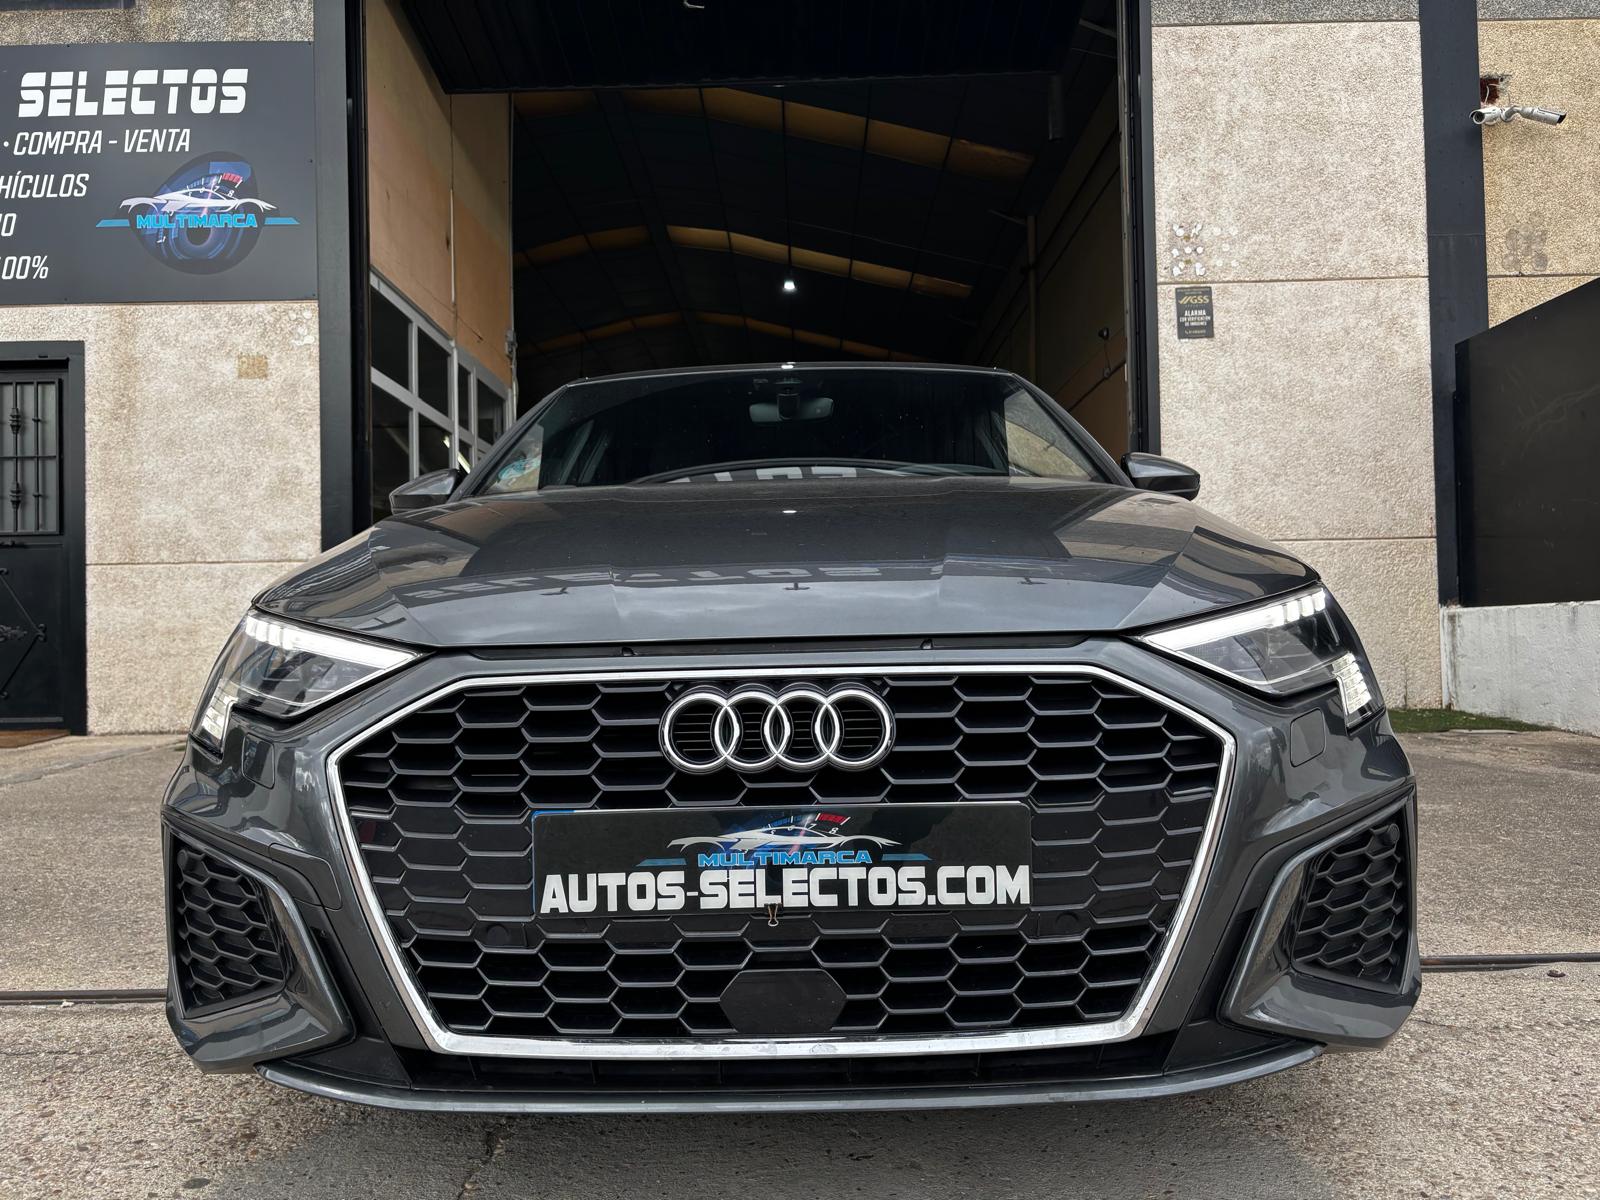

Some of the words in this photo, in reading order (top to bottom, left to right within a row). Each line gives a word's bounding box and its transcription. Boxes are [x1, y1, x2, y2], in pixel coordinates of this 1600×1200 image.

[18, 68, 249, 118] SELECTOS
[13, 130, 102, 155] COMPRA
[123, 128, 191, 153] VENTA
[136, 213, 258, 229] MULTIMARCA
[0, 255, 49, 280] 00%
[697, 850, 872, 867] MULTIMARCA
[540, 865, 1031, 914] AUTOS-SELECTOS.COM
